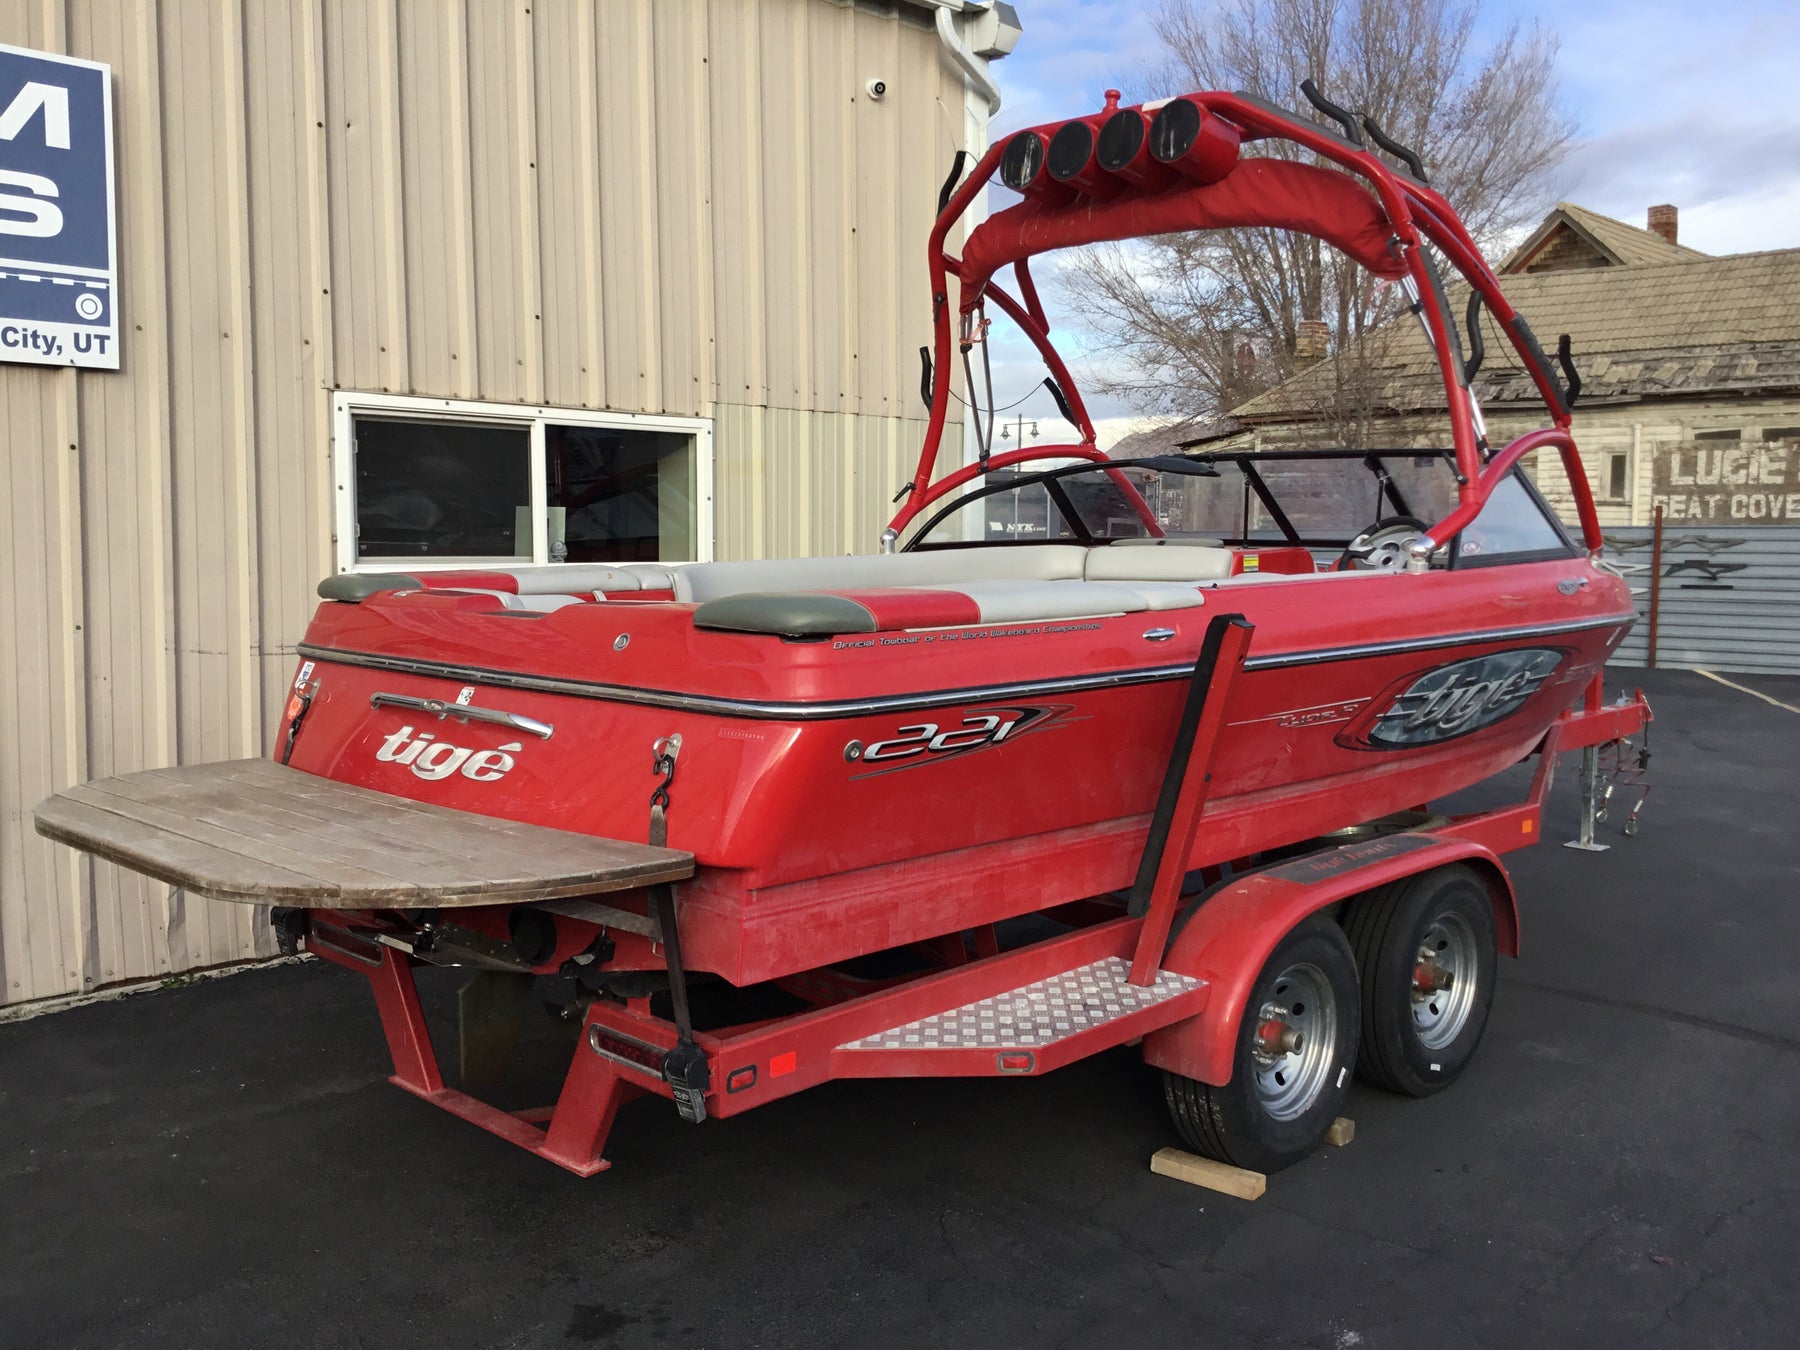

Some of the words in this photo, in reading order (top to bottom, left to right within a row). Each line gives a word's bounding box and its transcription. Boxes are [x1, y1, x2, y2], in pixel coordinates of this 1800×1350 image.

[1, 326, 63, 356] City,
[73, 332, 110, 354] UT
[375, 724, 524, 782] tigé
